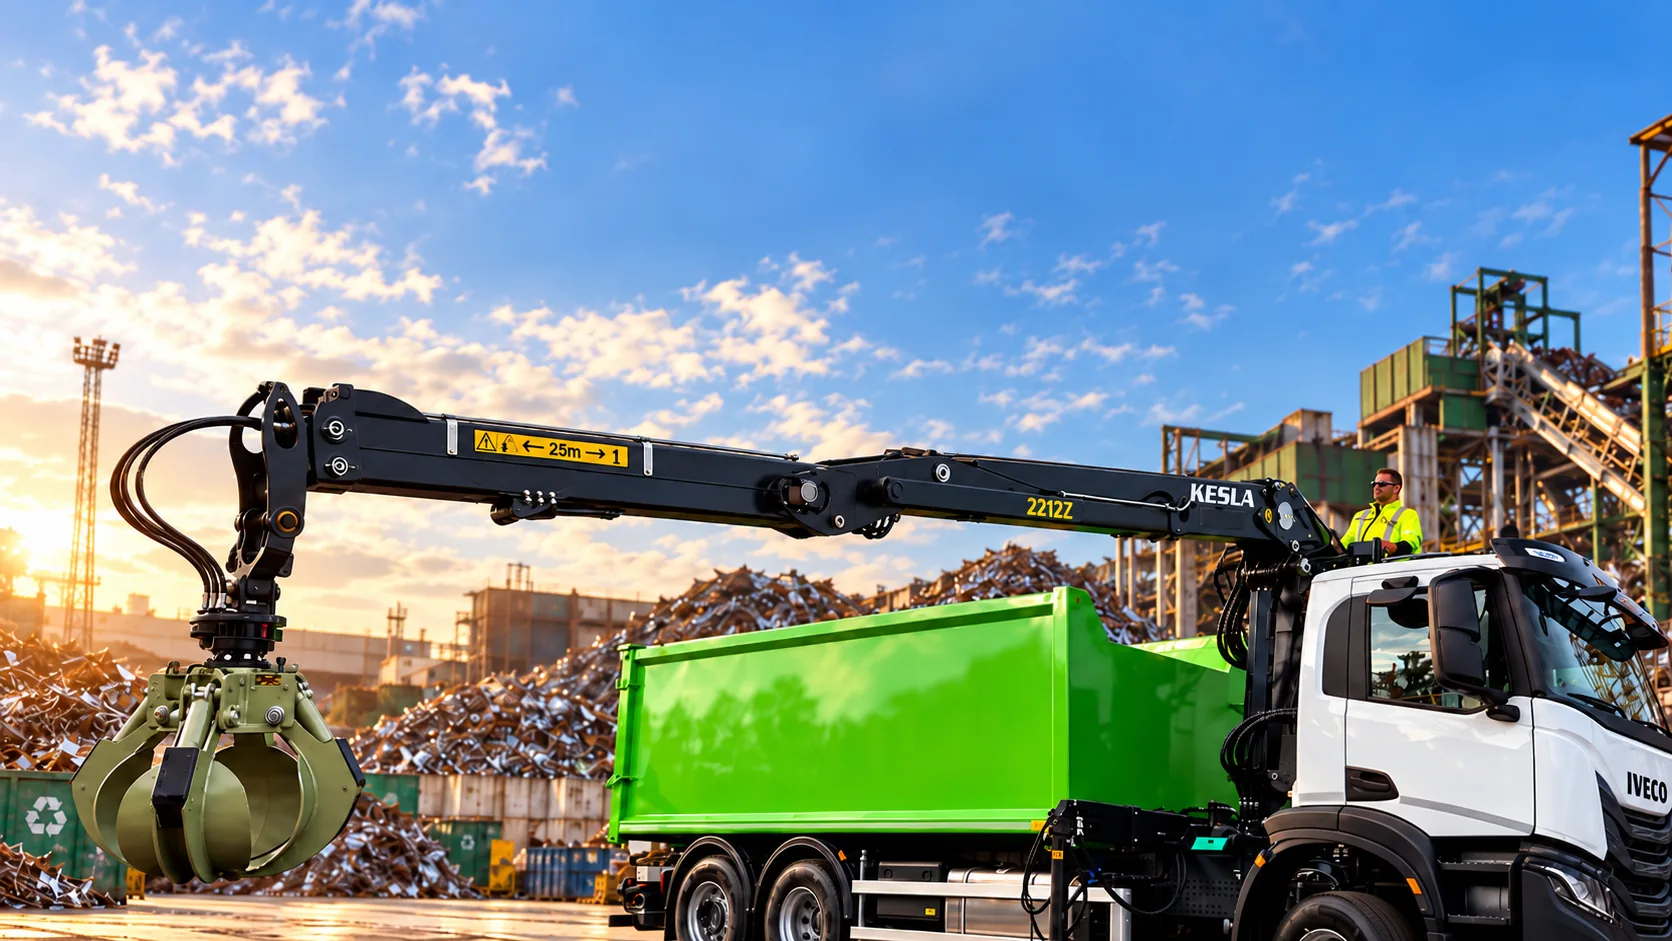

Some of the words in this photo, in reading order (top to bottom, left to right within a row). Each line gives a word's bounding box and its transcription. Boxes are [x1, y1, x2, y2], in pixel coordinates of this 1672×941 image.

[549, 442, 581, 458] 25m
[612, 449, 620, 464] 1
[1190, 483, 1254, 507] KESLA
[1027, 497, 1073, 520] 2212Z
[1627, 771, 1668, 804] IVECO
